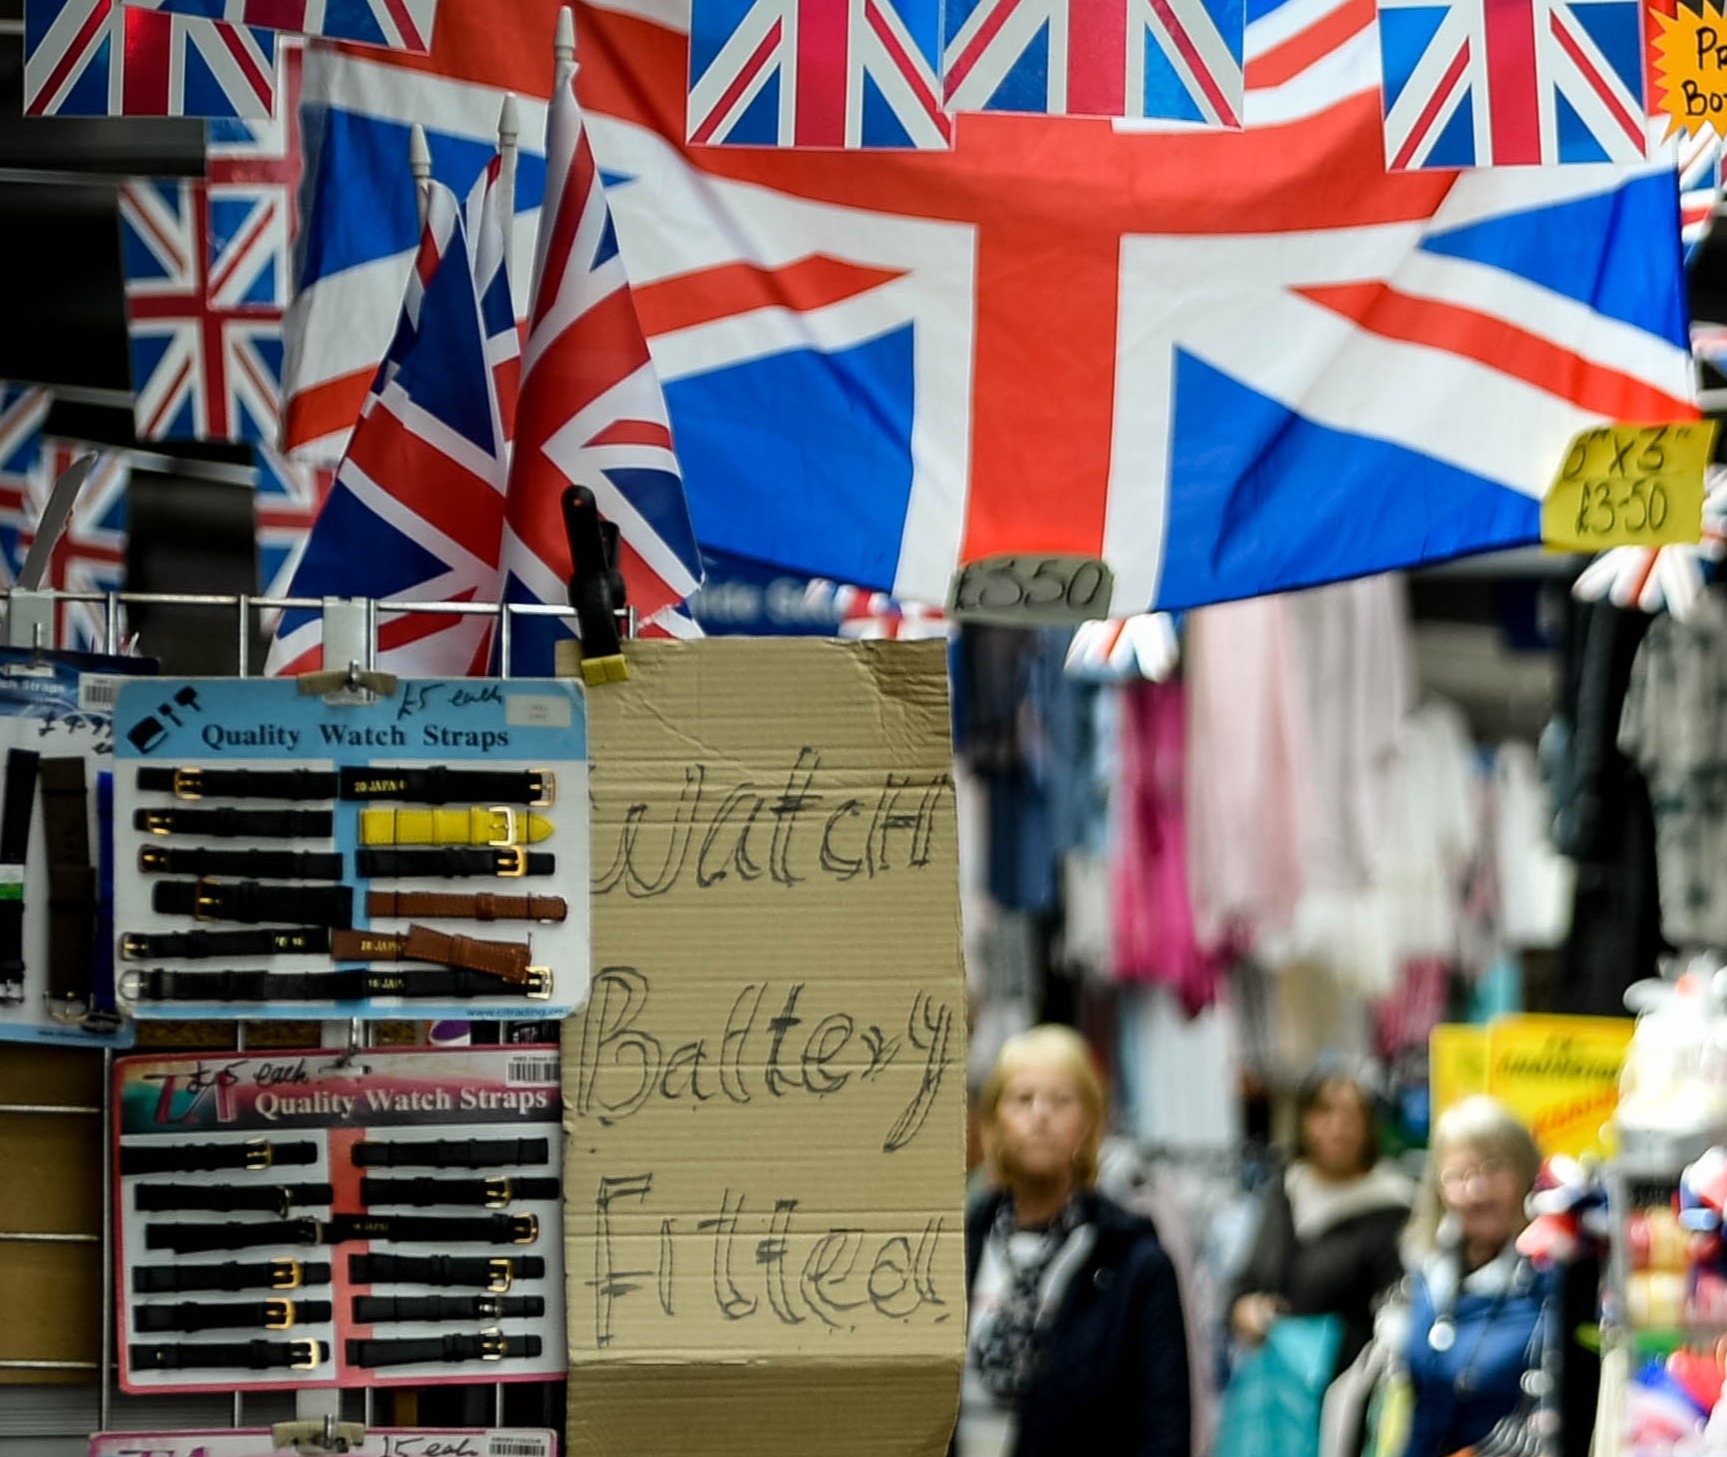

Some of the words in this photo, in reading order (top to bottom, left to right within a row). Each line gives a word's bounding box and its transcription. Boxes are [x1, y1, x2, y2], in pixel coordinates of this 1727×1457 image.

[201, 722, 300, 752] Quality
[318, 723, 406, 747] Watch
[422, 724, 510, 752] Straps
[253, 1089, 356, 1119] Quality
[363, 1086, 452, 1113] Watch
[458, 1084, 549, 1115] Straps
[577, 965, 953, 1153] Battery
[584, 1172, 948, 1349] Fitted
